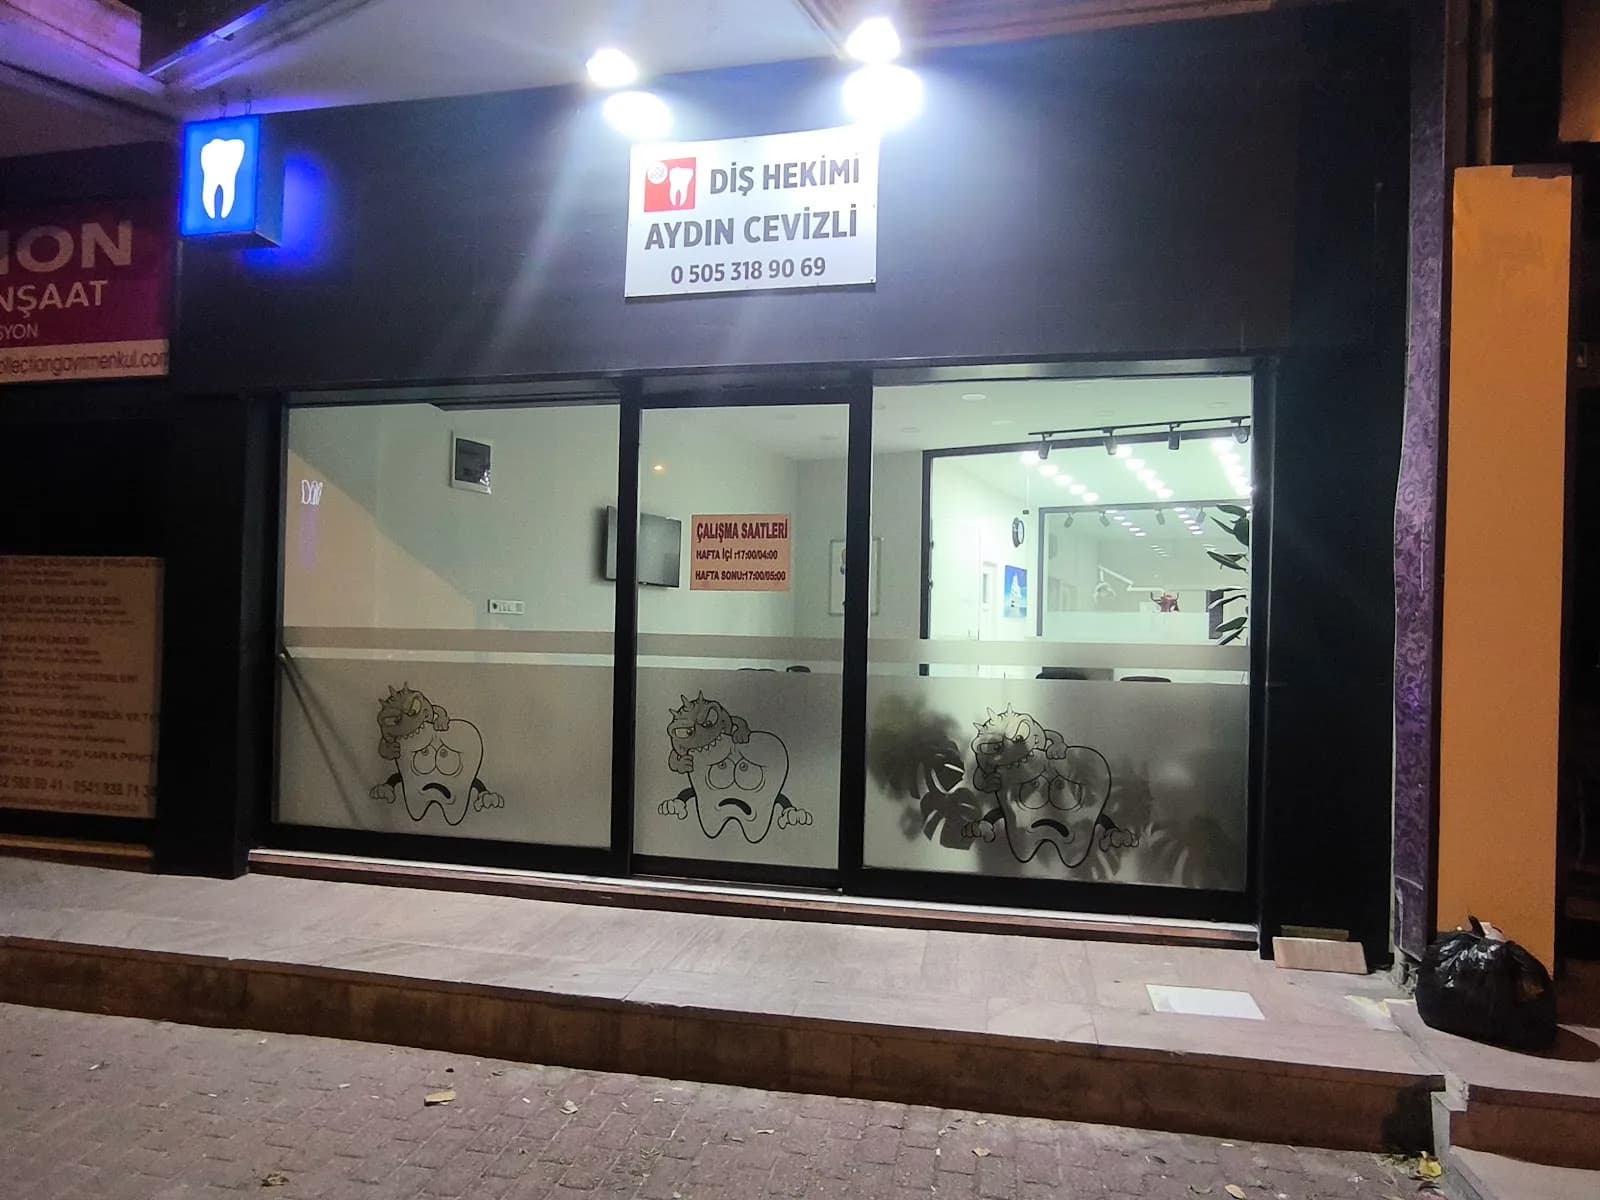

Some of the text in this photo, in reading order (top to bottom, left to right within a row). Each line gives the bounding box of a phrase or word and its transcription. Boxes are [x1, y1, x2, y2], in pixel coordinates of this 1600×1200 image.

[710, 152, 860, 196] DİŞ HEKİMİ
[644, 204, 857, 250] AYDIN CEVİZLİ
[671, 256, 826, 285] 0 505 318 90 69
[696, 518, 788, 543] ÇALIŞMA SAATLERİ
[696, 549, 720, 560] HAFTA
[722, 547, 732, 561] İÇİ
[695, 570, 720, 580] HAFTA
